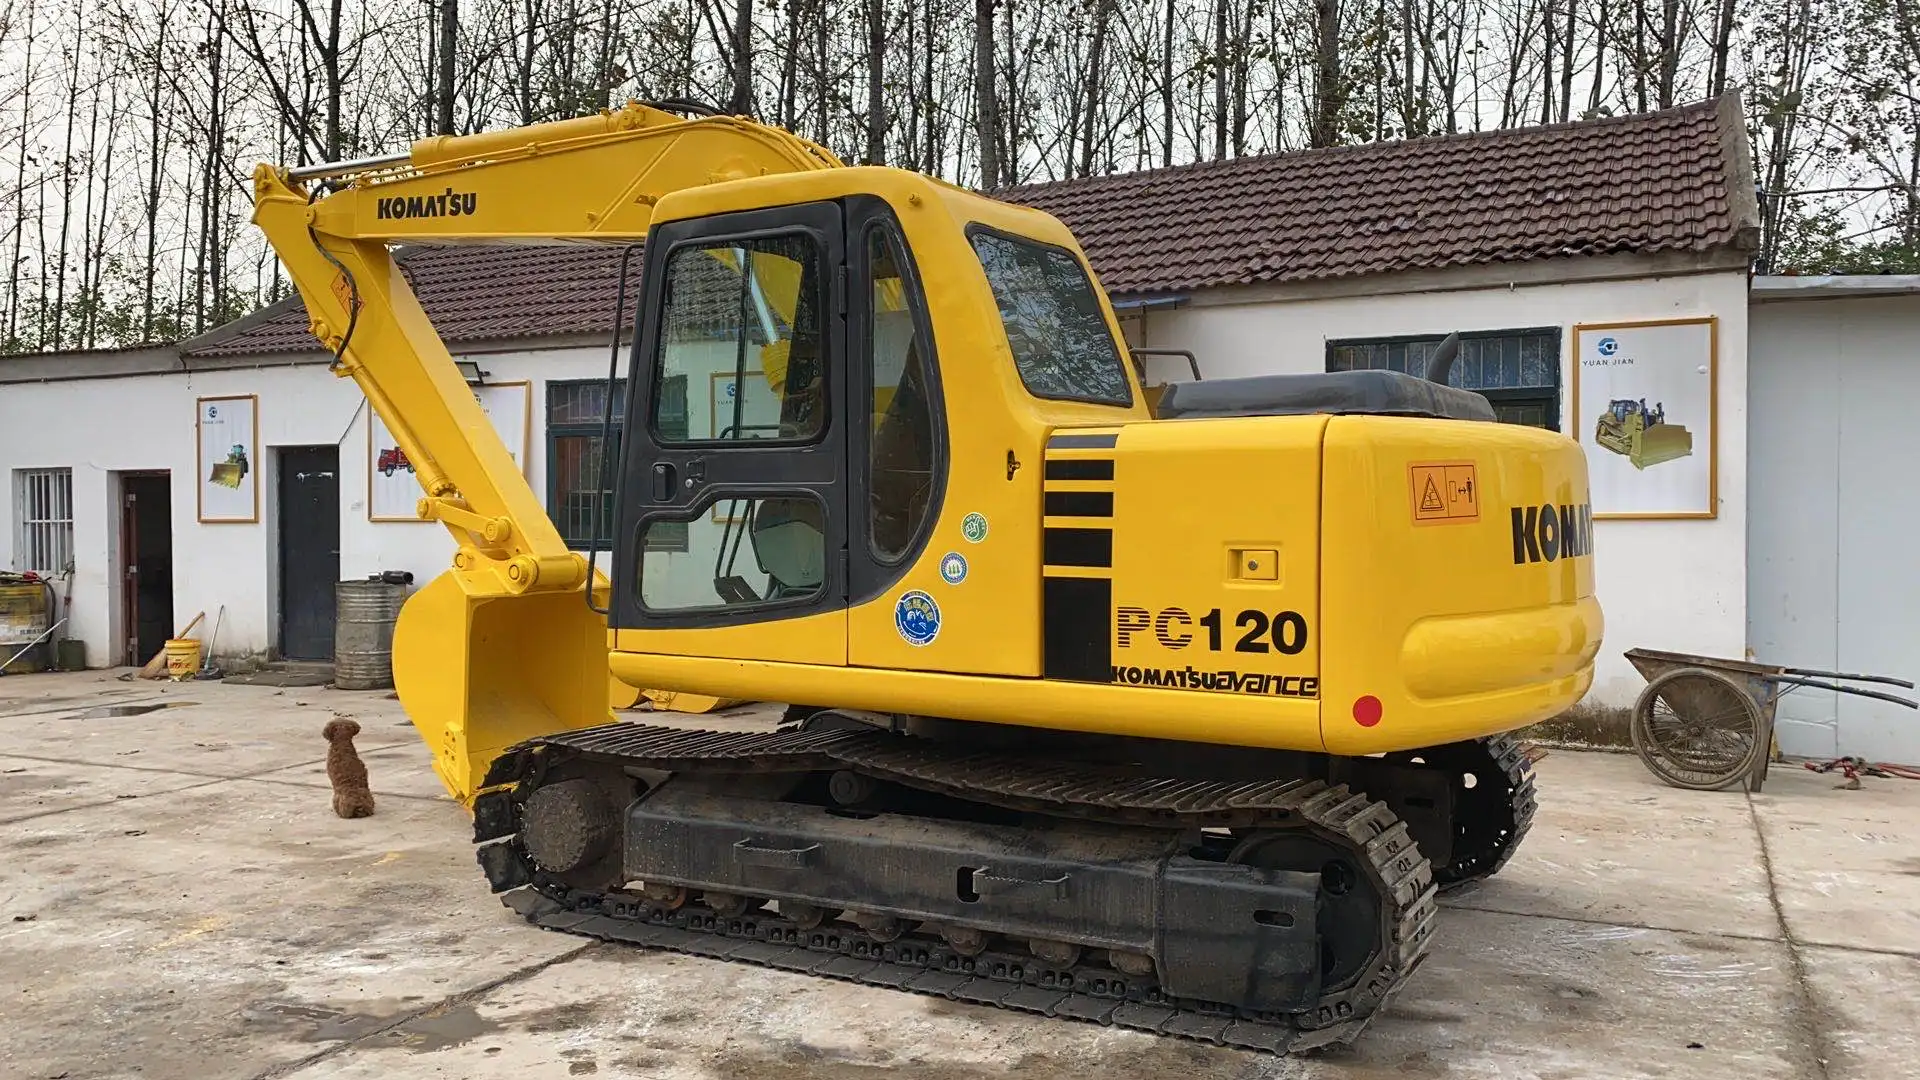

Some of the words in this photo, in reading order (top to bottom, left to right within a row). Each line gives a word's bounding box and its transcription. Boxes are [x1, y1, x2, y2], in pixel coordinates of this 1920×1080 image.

[378, 188, 477, 219] KOMATSU
[1583, 359, 1608, 367] YUAN
[1612, 358, 1634, 366] JIAN
